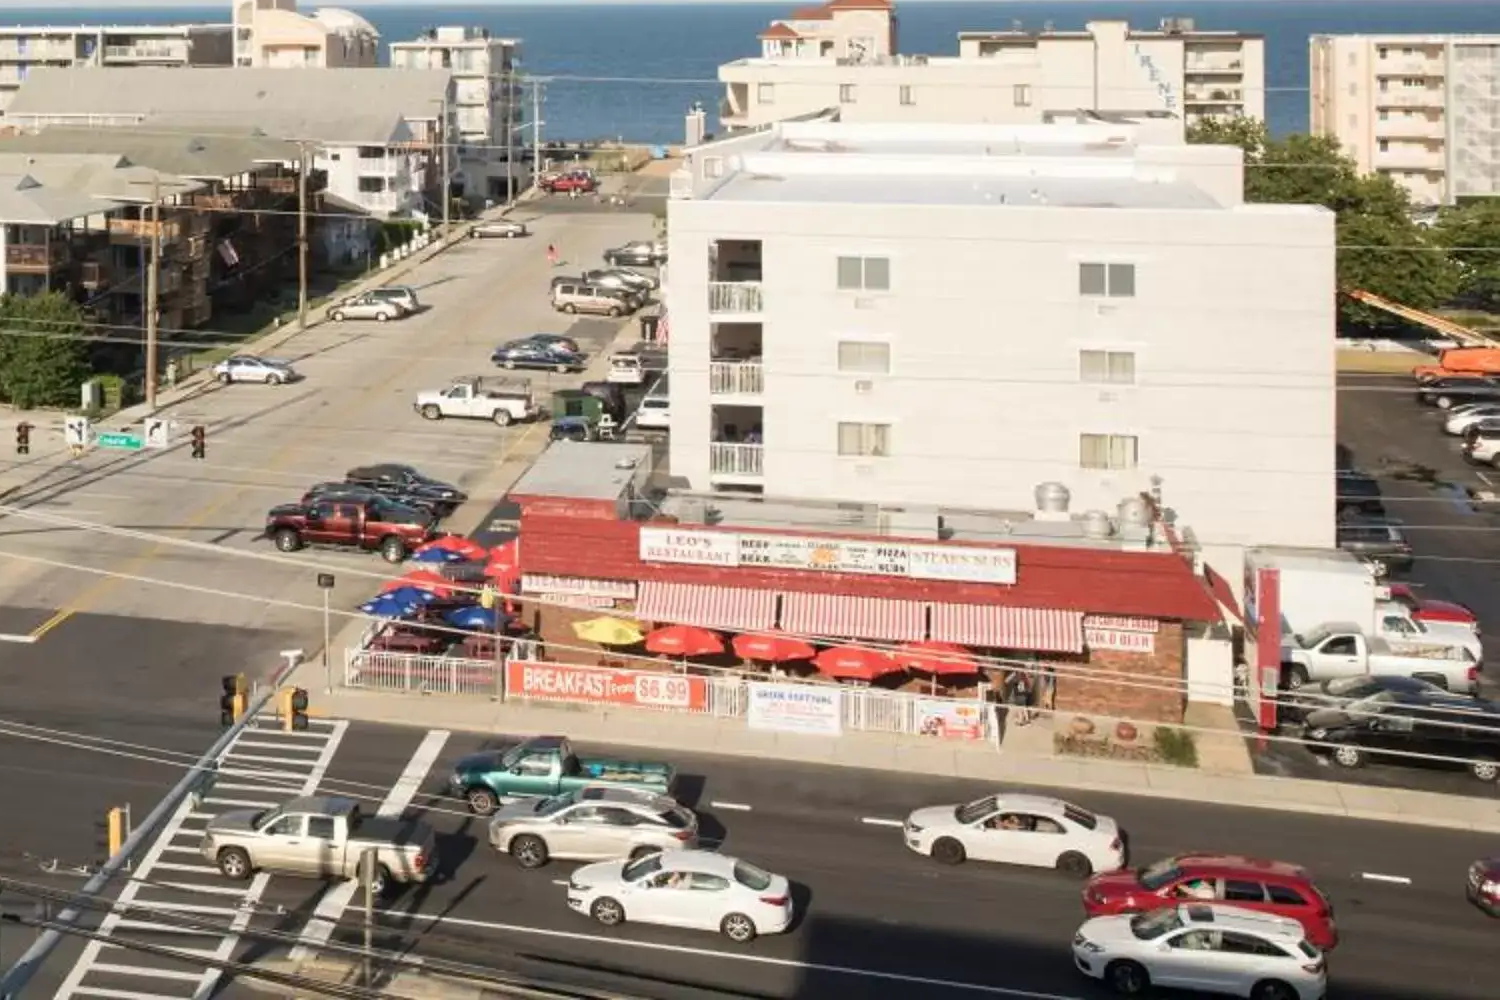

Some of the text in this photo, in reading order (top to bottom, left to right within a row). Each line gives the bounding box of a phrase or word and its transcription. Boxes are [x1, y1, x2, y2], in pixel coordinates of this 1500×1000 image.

[665, 534, 712, 548] LEO'S
[877, 547, 907, 558] PIZZA
[523, 666, 613, 696] BREAKFAST
[639, 677, 687, 700] $6.99
